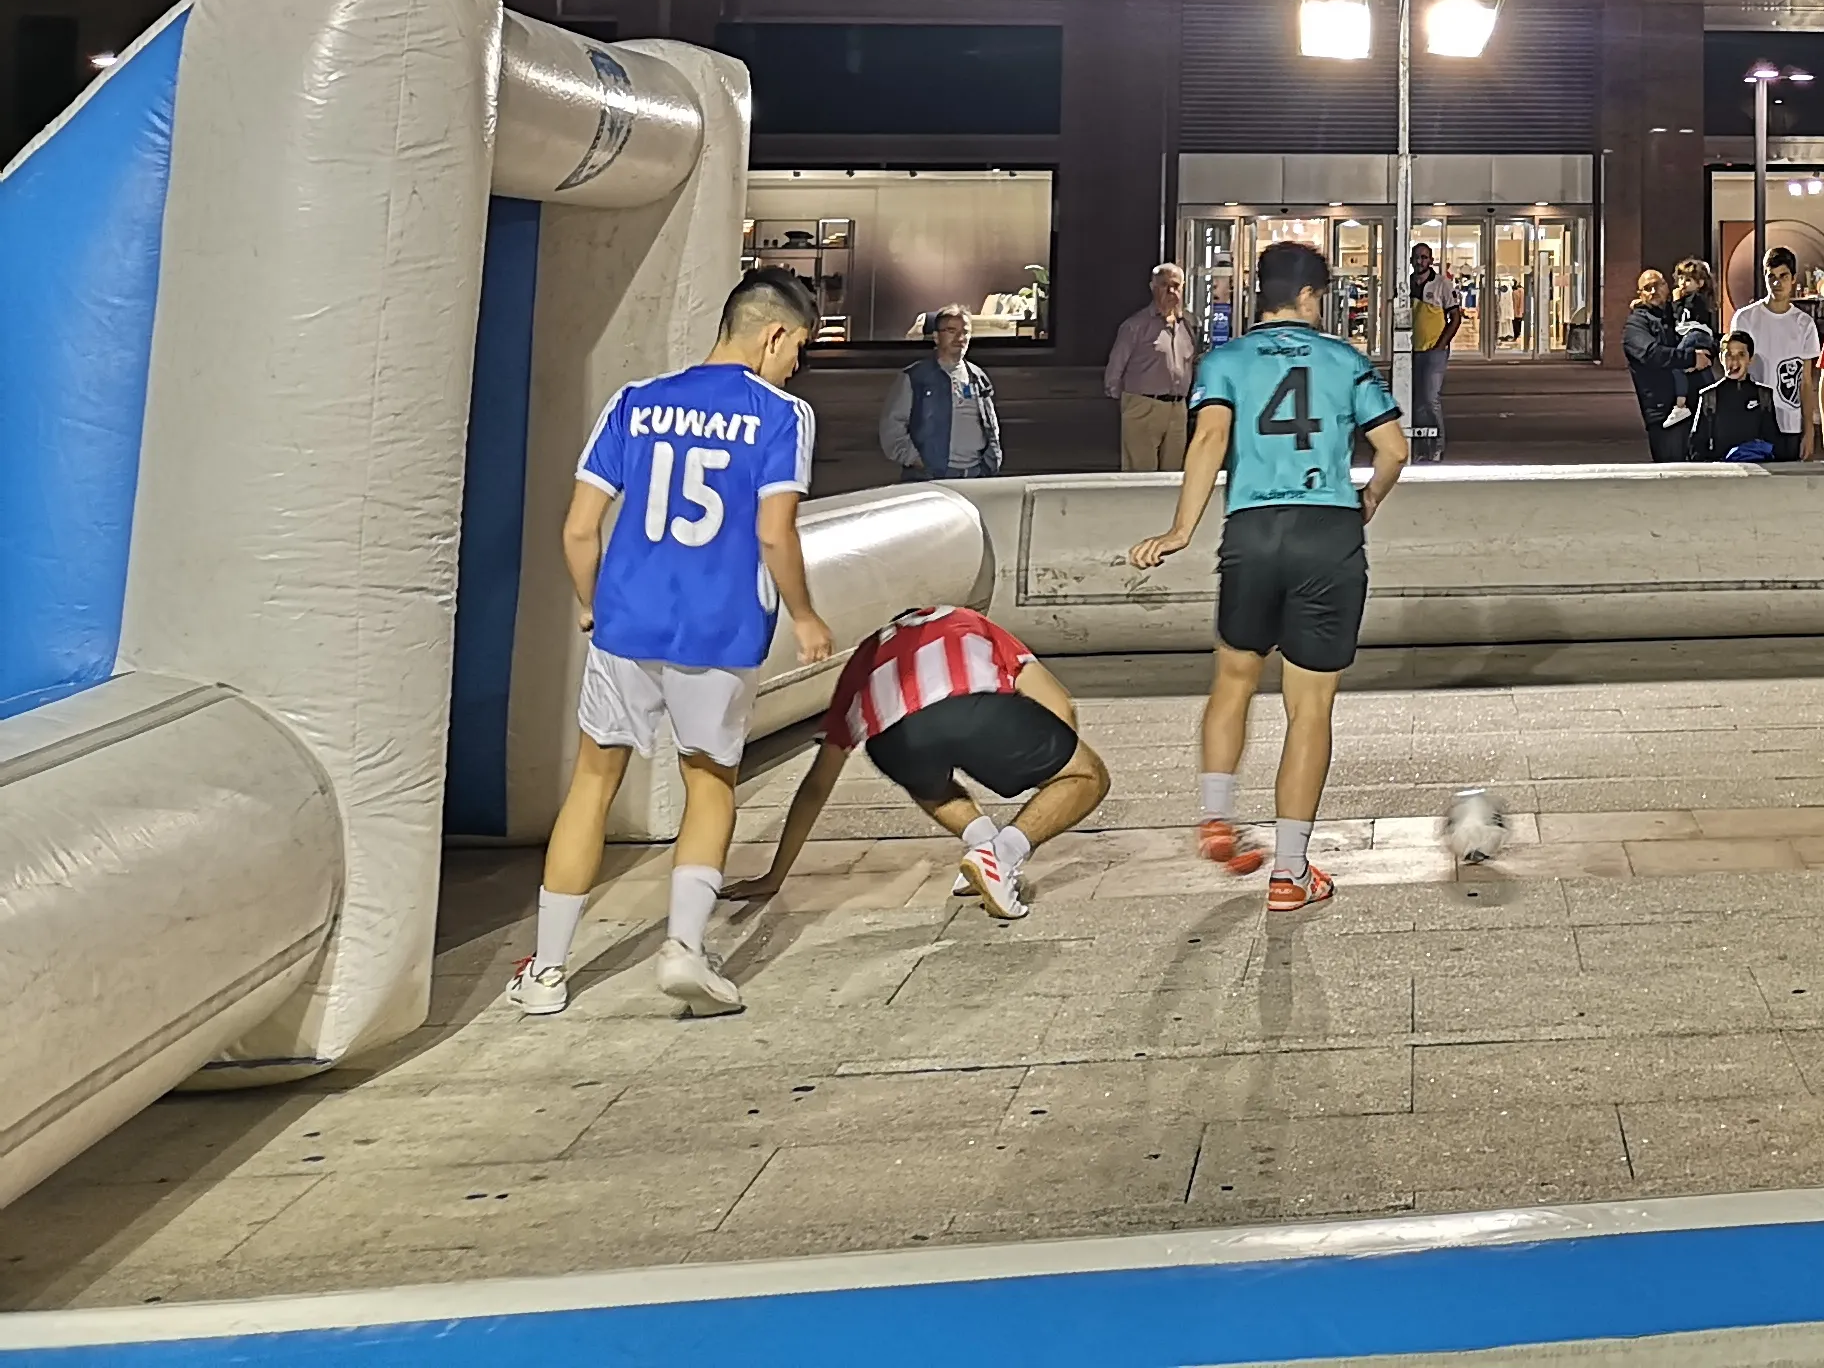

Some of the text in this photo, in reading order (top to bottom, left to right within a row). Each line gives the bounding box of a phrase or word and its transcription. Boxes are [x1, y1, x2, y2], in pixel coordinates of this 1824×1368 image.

[629, 405, 761, 445] KUWAIT
[1257, 366, 1323, 451] 4
[644, 441, 731, 547] 15
